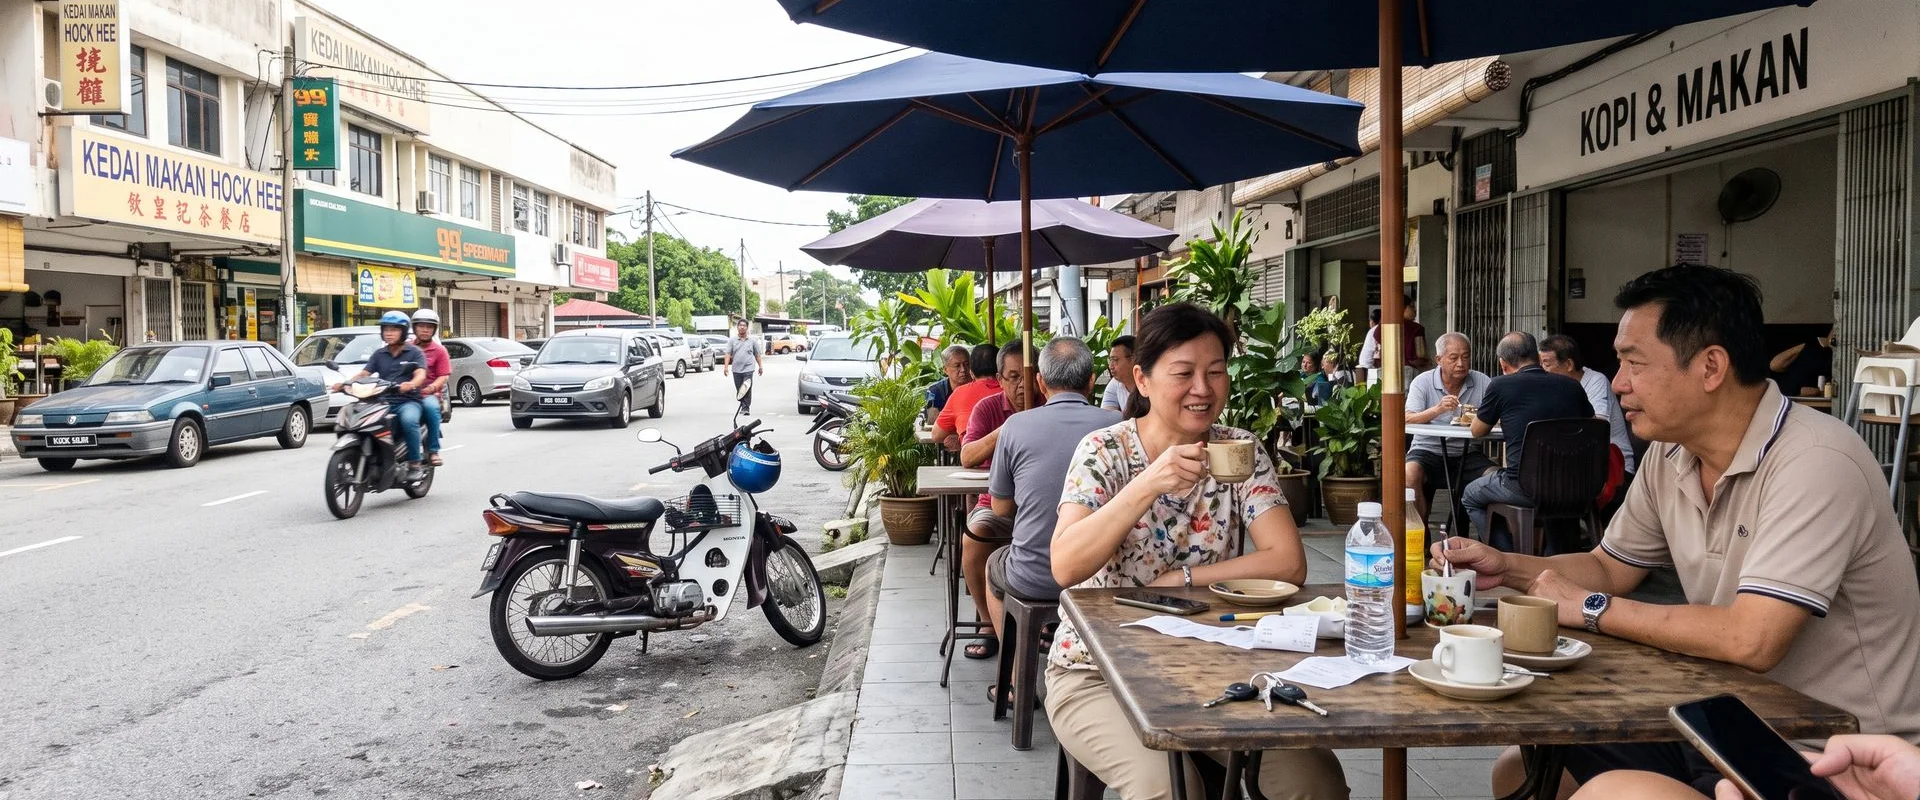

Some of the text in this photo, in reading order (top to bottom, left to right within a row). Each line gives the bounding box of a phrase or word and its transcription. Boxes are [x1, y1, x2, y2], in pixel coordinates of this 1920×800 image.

[64, 4, 116, 19] KEDAI MAKAN
[65, 23, 116, 42] HOCK HEE
[311, 28, 343, 65] KEDAI
[345, 44, 380, 84] MAKAN
[293, 88, 328, 107] 99
[1580, 26, 1809, 157] KOPI & MAKAN
[83, 139, 282, 212] KEDAI MAKAN HOCK HEE
[436, 227, 510, 264] 99 SPEEDMART
